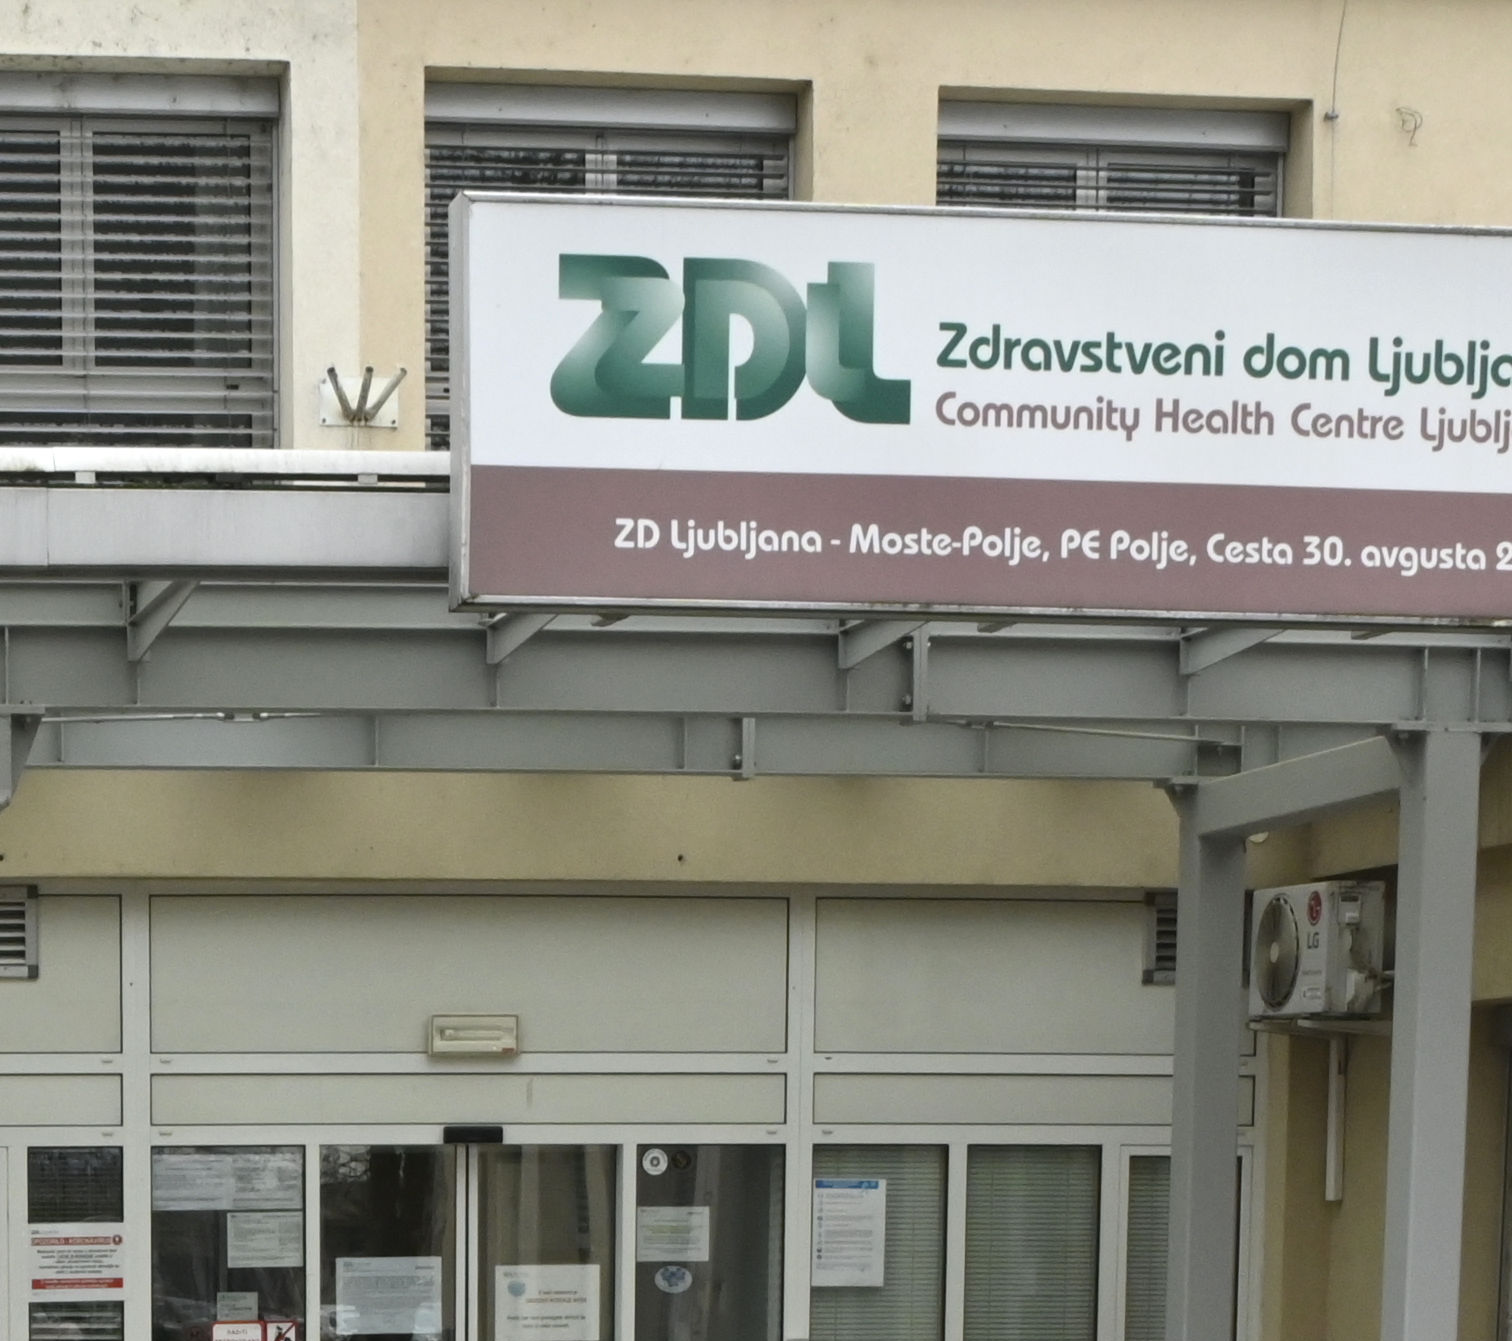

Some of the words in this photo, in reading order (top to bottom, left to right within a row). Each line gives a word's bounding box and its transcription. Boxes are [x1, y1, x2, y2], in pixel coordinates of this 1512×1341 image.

[550, 253, 911, 424] ZDL
[936, 322, 1225, 376] Zdravstveni
[1243, 332, 1350, 382] dom
[936, 391, 1140, 441] Community
[1155, 398, 1274, 436] Health
[1291, 402, 1404, 440] Centre
[614, 518, 660, 549] ZD
[670, 519, 822, 560] Ljubljana
[849, 523, 1050, 566] Moste-Polje,
[1061, 529, 1100, 559] PE
[1110, 530, 1197, 569] Polje,
[1207, 533, 1293, 564] Cesta
[1303, 535, 1352, 566] 30.
[1361, 543, 1487, 576] avgusta
[1307, 931, 1320, 949] LG
